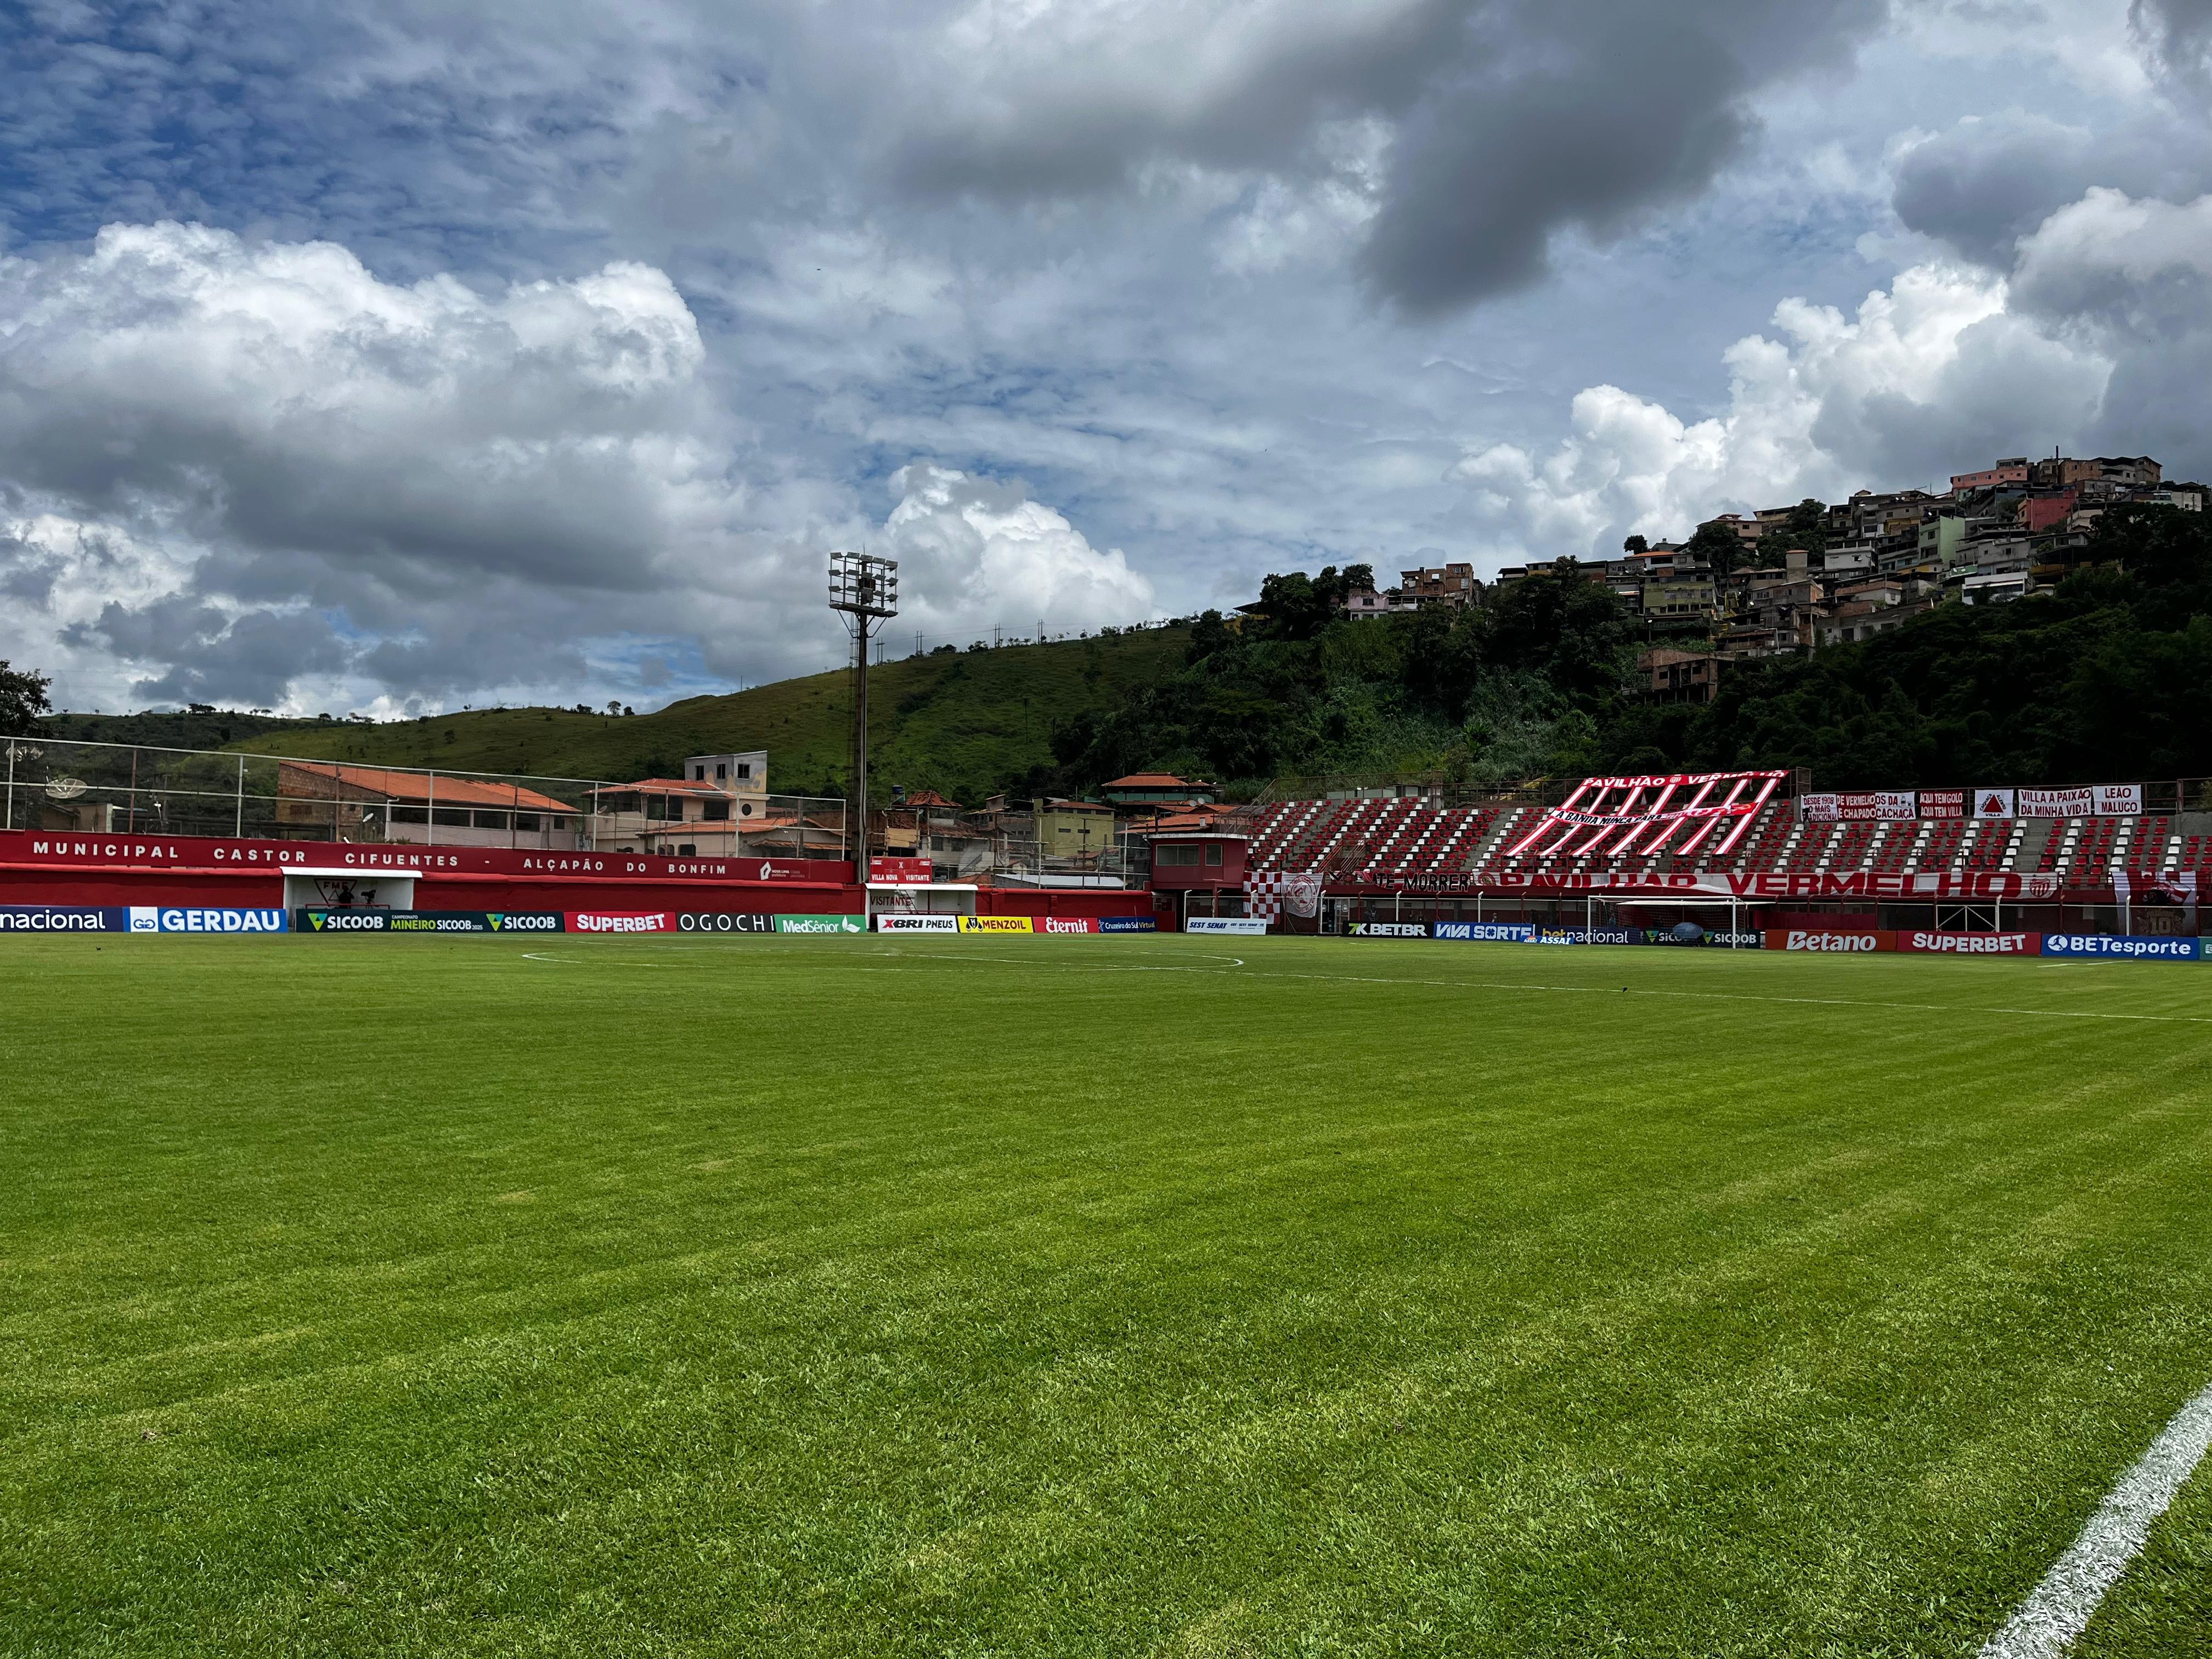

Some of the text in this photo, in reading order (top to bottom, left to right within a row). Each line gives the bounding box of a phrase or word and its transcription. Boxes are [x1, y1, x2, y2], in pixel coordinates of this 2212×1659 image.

[1837, 795, 1875, 806] DE VERMELHO
[1875, 795, 1898, 805] OS DA
[1920, 792, 1963, 804] AQUI TEM GOLO
[2021, 791, 2046, 802] VILLA
[2049, 793, 2055, 803] A
[1838, 808, 1876, 819] E CHAPADO
[1921, 806, 1963, 817] AQUI TEM VILLA
[2021, 803, 2088, 816] DA MINHA VIDA
[2102, 802, 2137, 812] MALUCO
[1565, 812, 1599, 825] BANDA
[1803, 813, 1838, 821] TADICIONAL
[1876, 808, 1914, 820] CACHAÇA
[33, 842, 178, 859] MUNICIPAL
[214, 848, 304, 862] CASTOR
[345, 853, 458, 866] CIFUENTES
[523, 858, 603, 871] ALÇAPÃO
[627, 862, 646, 872] DO
[668, 864, 726, 874] BONFIM
[1404, 873, 1469, 891] MORRER
[1725, 872, 2022, 898] VERMELHO
[870, 896, 911, 906] VISITANTE
[162, 910, 280, 931] GERDAU
[327, 916, 383, 929] SICOOB
[391, 920, 436, 929] MINEIRO
[437, 920, 471, 929] SICOOB
[504, 916, 556, 929] SICOOB
[577, 913, 664, 932] SUPERBET
[680, 914, 775, 931] OGOCHI
[783, 920, 839, 933] MedSênior
[883, 919, 953, 929] XBRI PNEUS
[983, 918, 1026, 929] MENZOIL
[1348, 923, 1427, 936] 7K.BET.BR
[1436, 924, 1532, 940] VIVA SORTE
[1658, 932, 1684, 942] SICO
[1714, 934, 1756, 944] SICOOB
[1786, 932, 1876, 951] Betano
[1912, 933, 2025, 952] SUPERBET
[2070, 936, 2191, 956] BETesporte
